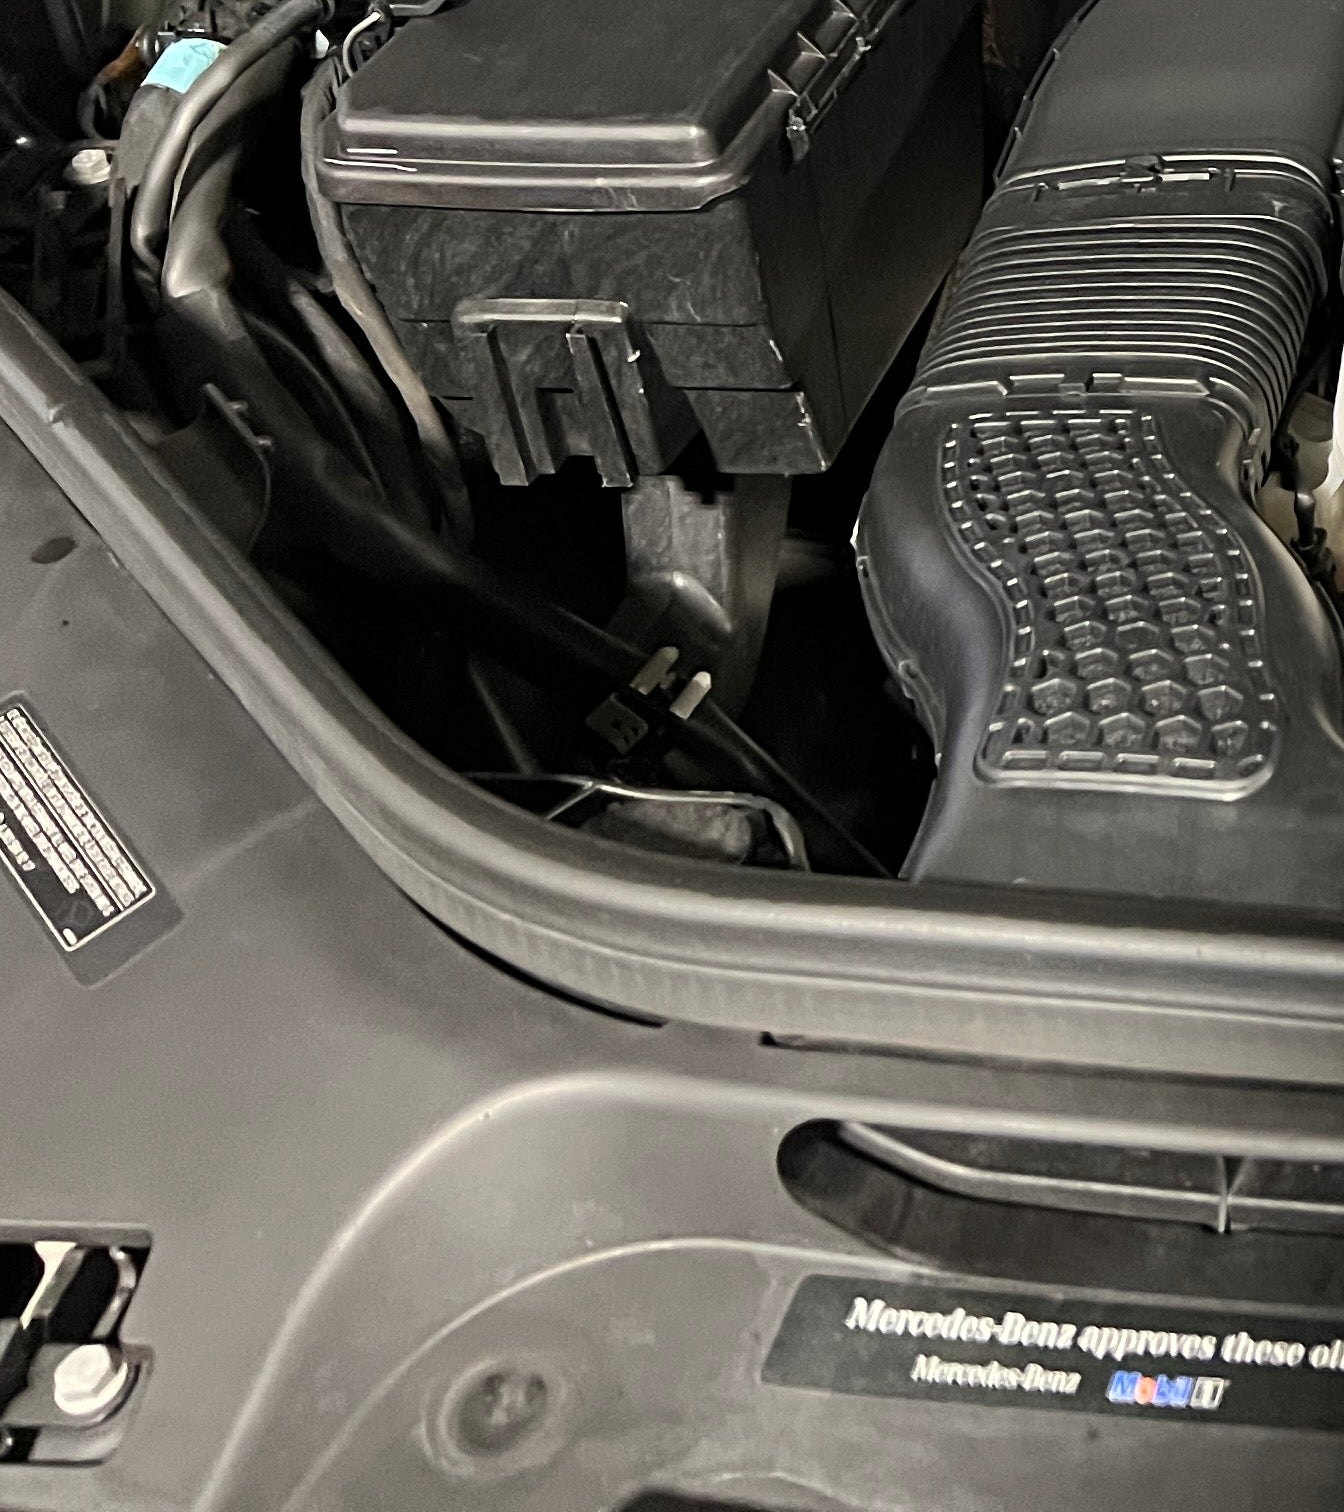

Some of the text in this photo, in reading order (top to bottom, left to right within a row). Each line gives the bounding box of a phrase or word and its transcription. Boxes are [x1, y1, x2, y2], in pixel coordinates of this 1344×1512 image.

[844, 1296, 1077, 1350] Mercedes-Benz
[1077, 1324, 1217, 1362] approves
[1220, 1330, 1306, 1368] these
[910, 1353, 1082, 1396] Mercedes-Benz
